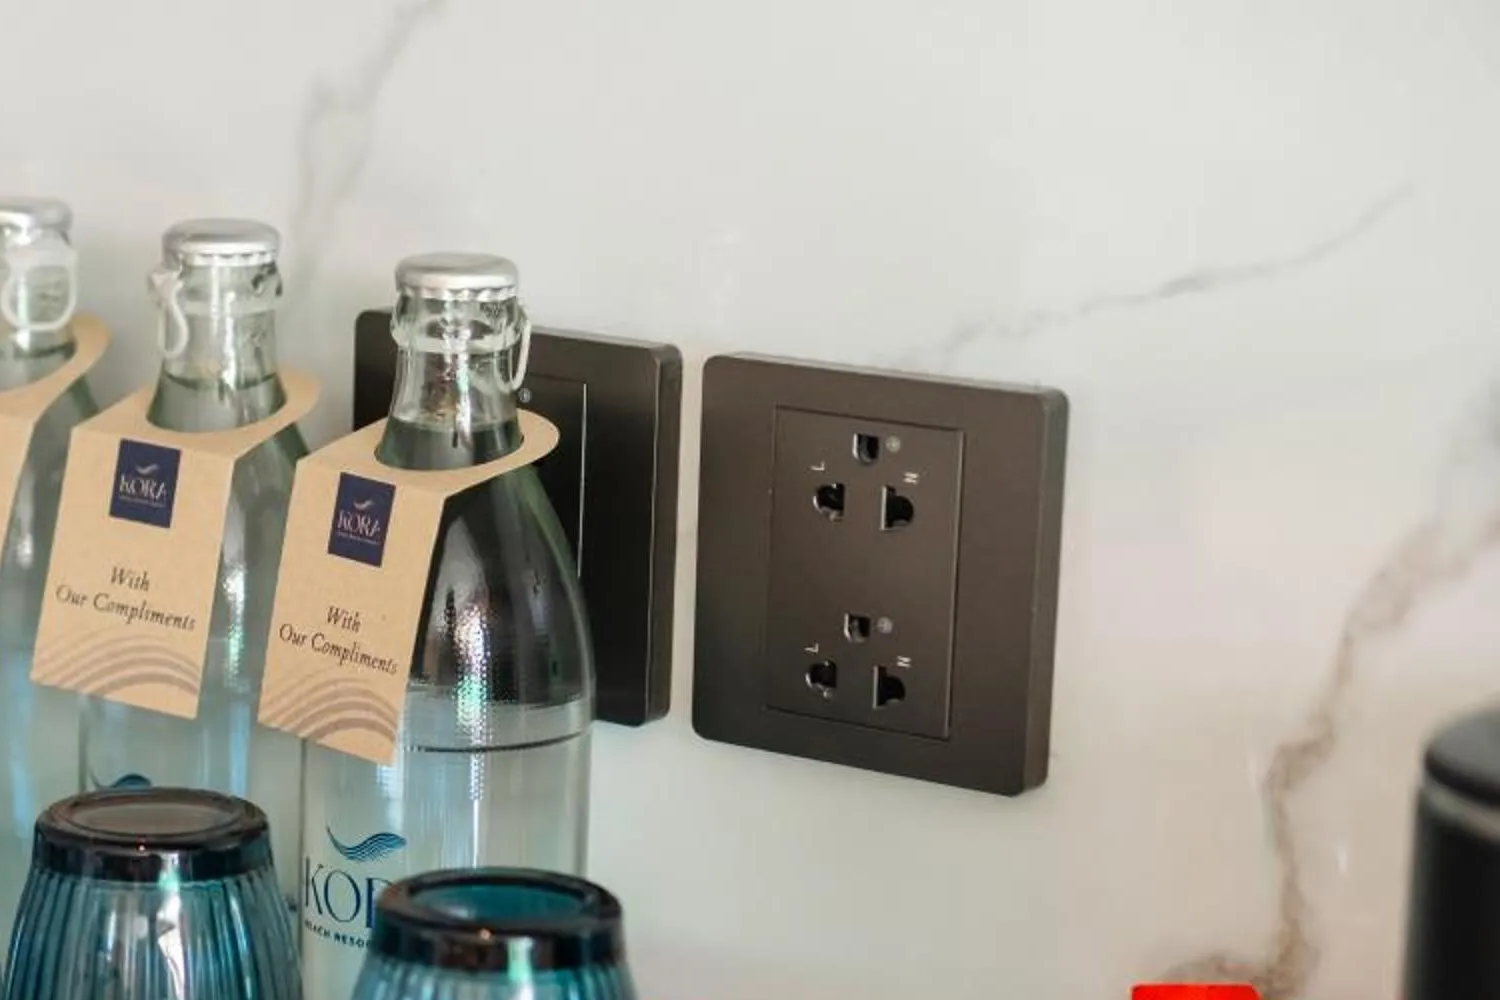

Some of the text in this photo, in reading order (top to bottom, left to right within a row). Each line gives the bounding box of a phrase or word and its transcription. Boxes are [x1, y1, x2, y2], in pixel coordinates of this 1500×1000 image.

[119, 473, 167, 500] KORA
[337, 509, 381, 537] KORA
[110, 566, 150, 591] With
[55, 583, 196, 632] Our Compliments
[327, 605, 361, 633] With
[279, 623, 398, 676] Our Compliments
[333, 932, 372, 948] RESO
